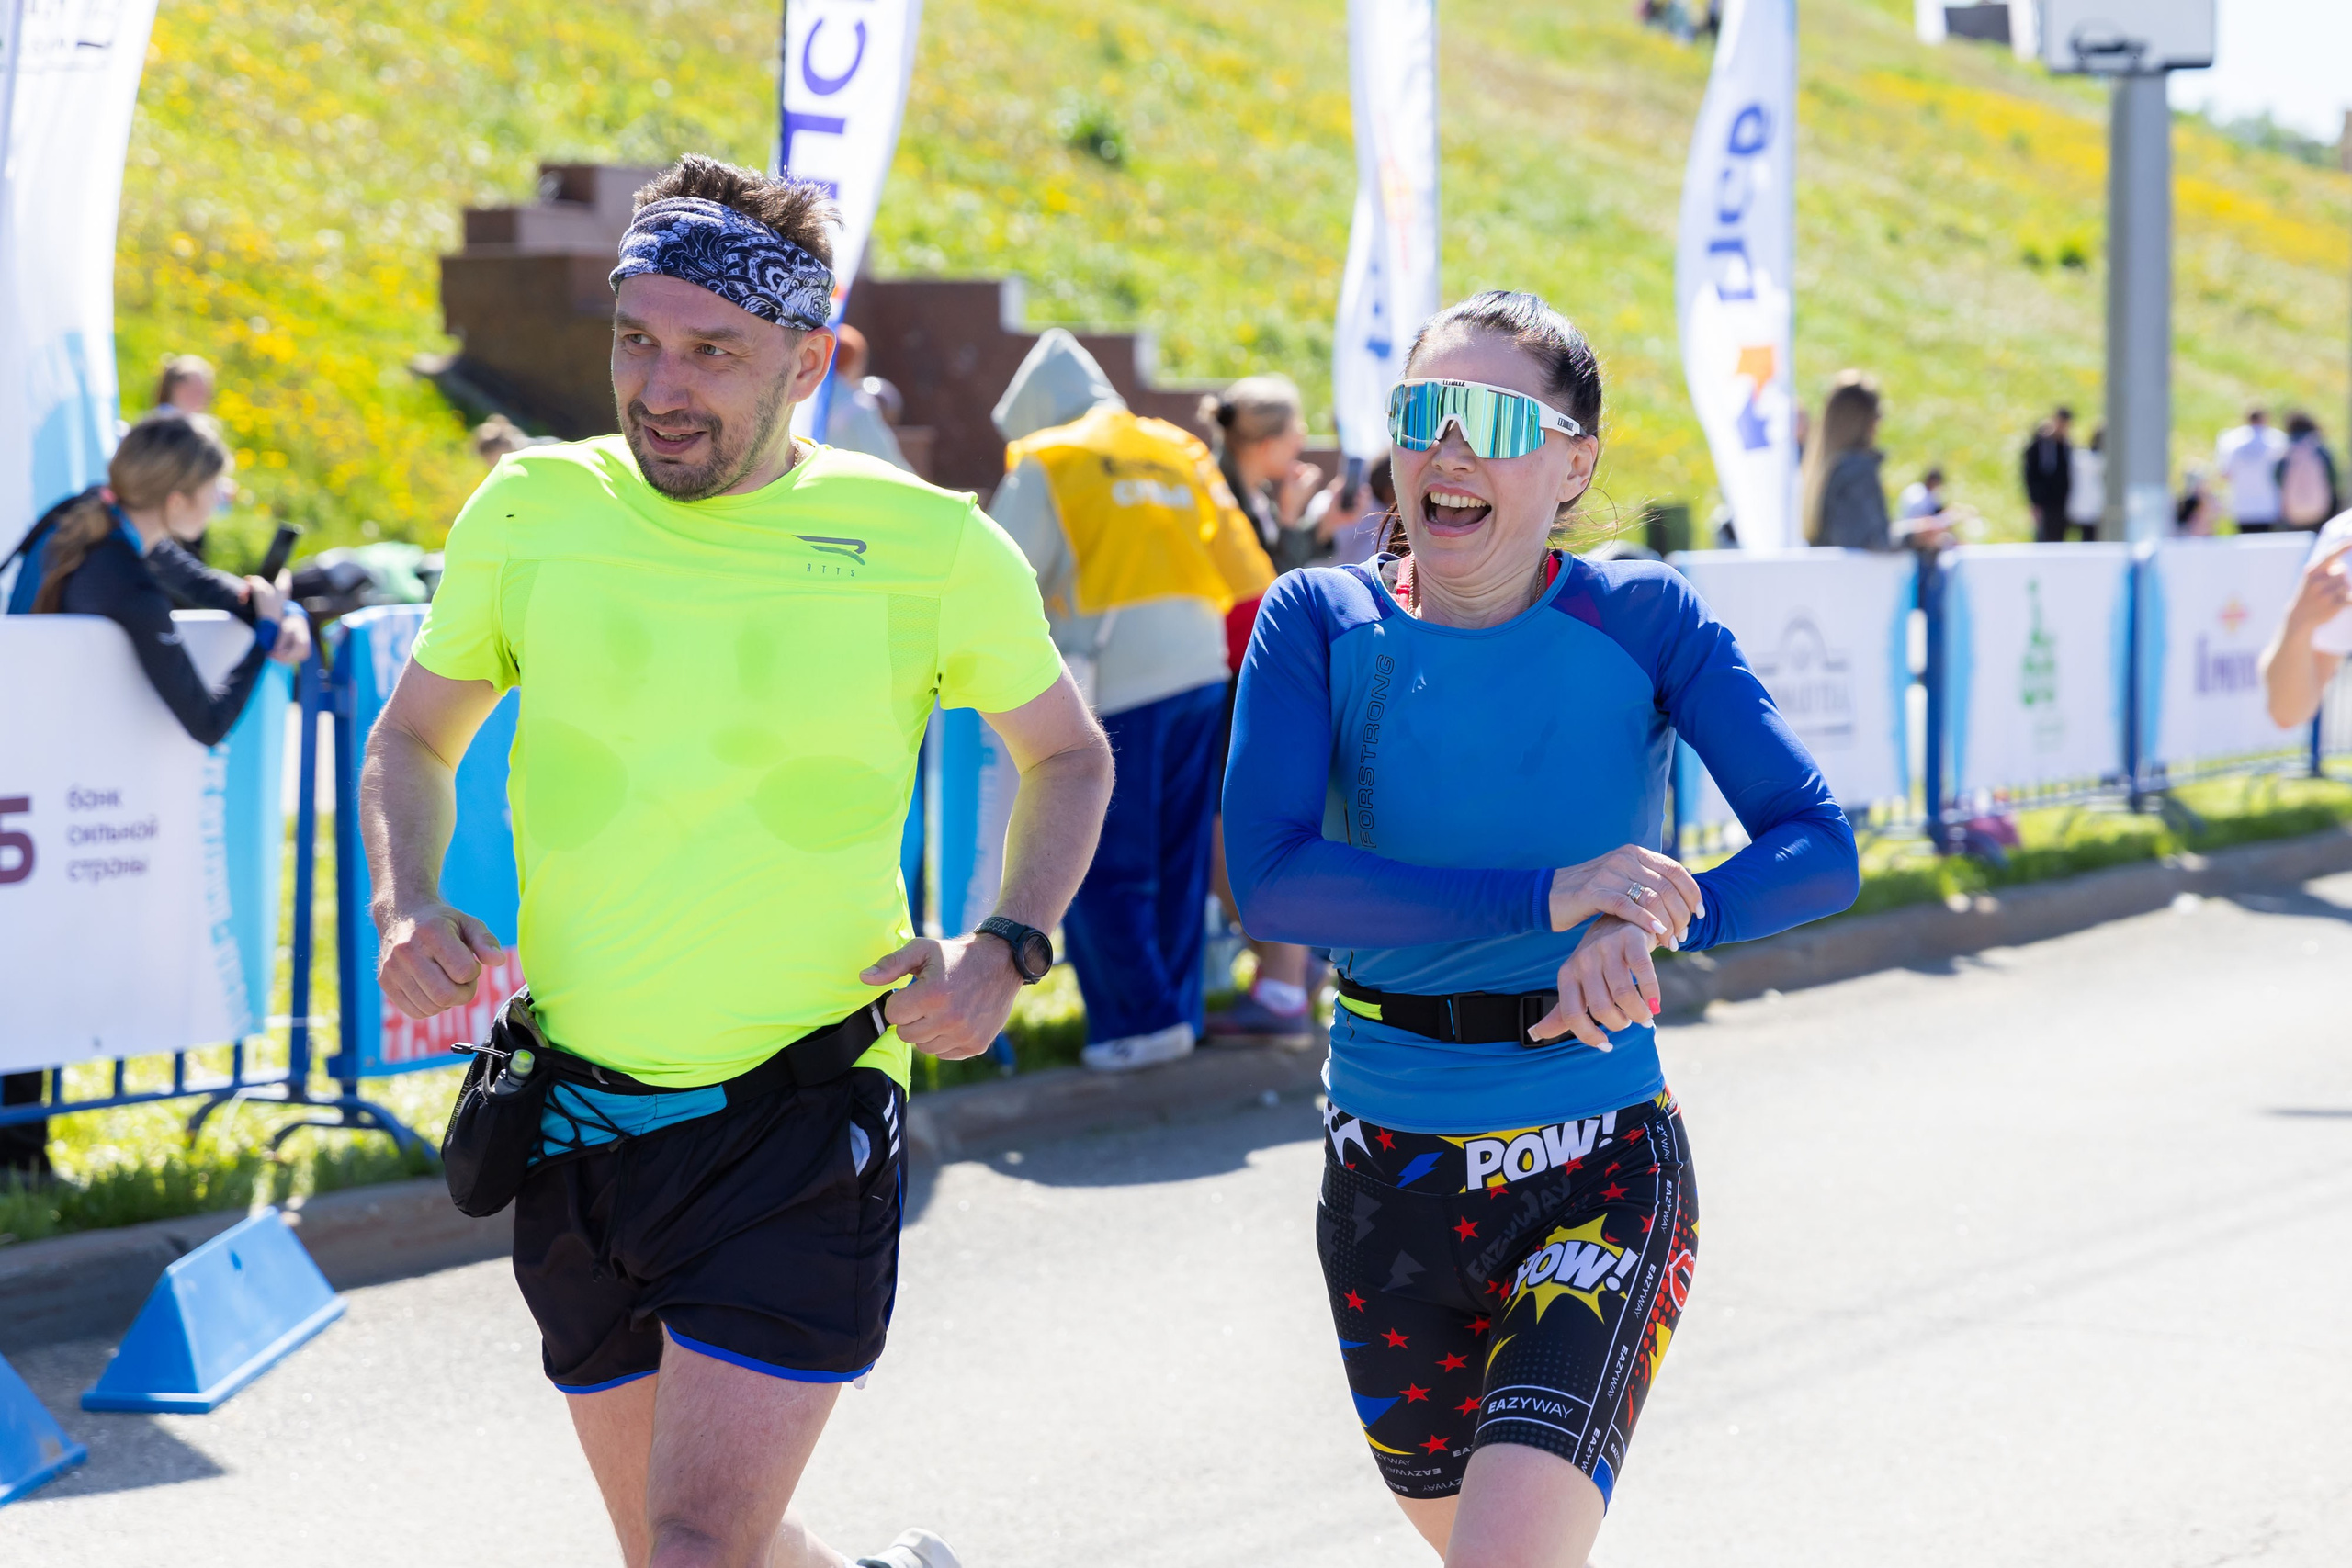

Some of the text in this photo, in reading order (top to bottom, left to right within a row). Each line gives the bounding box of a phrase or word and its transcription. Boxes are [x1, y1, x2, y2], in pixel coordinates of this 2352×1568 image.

[1357, 653, 1395, 849] FORSTRONG
[1465, 1110, 1617, 1190] POW!
[1656, 1121, 1670, 1161] ZYWAY
[1466, 1175, 1571, 1284] EAZYWAY
[1660, 1179, 1672, 1234] EAZYWAY
[1634, 1263, 1657, 1319] EAZYWAY
[1608, 1344, 1629, 1401] EAZYWAY
[1487, 1396, 1573, 1419] EAZYWAY
